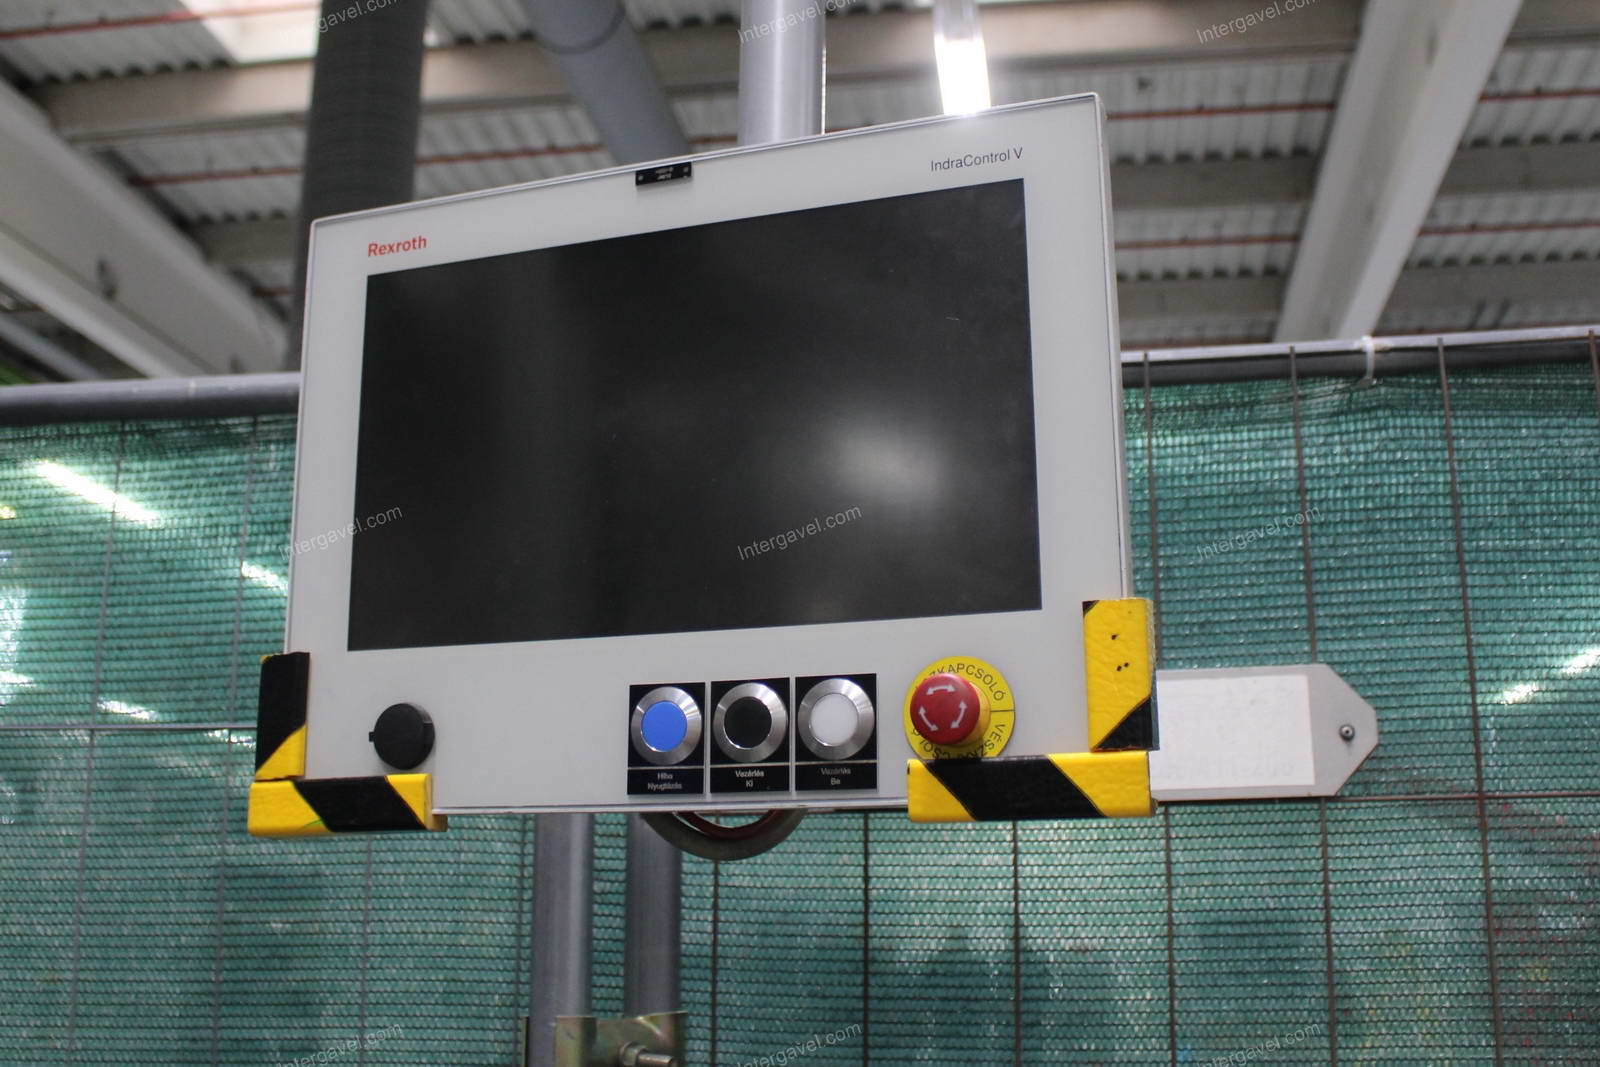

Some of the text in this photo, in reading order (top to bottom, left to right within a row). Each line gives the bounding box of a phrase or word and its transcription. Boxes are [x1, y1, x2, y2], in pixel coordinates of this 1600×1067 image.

[930, 147, 1023, 171] IndraControl V
[368, 235, 427, 258] Rexroth
